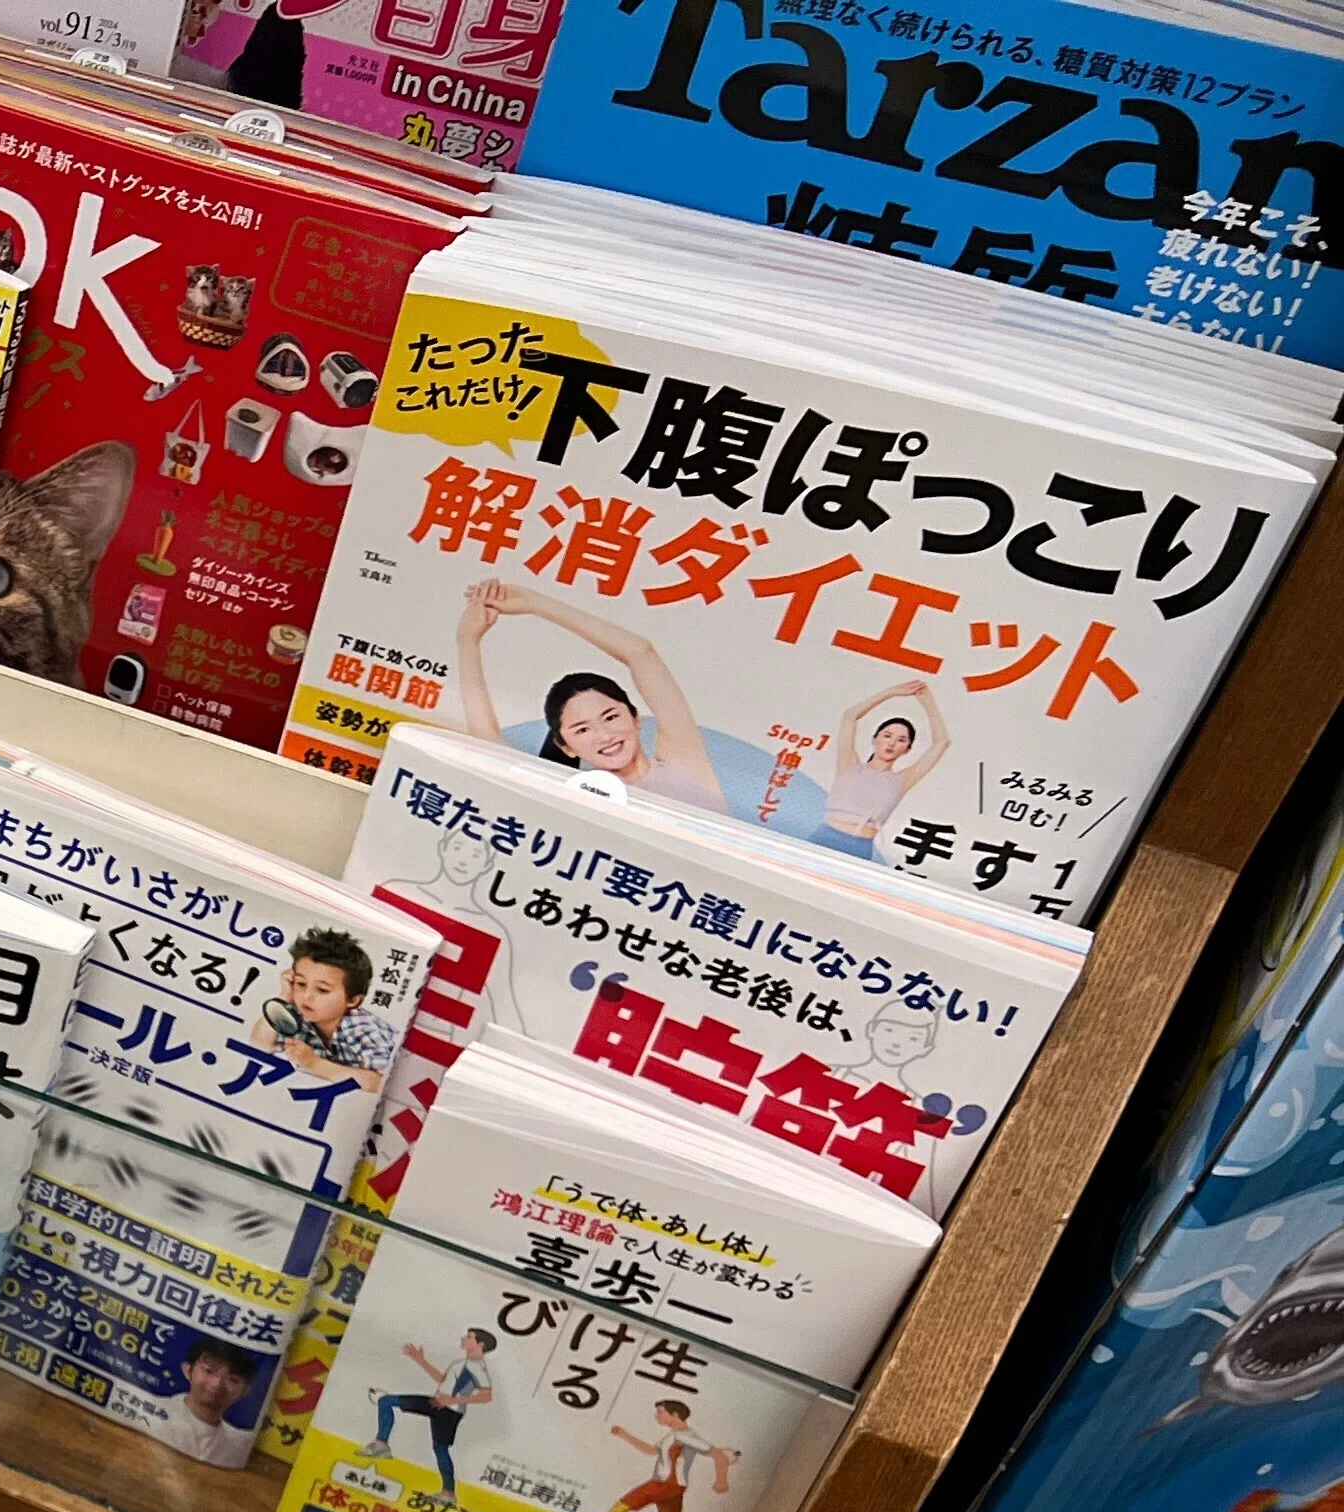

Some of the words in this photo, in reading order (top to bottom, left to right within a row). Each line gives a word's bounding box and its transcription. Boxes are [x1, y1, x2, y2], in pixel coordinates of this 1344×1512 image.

[392, 67, 419, 96] in
[426, 71, 527, 121] China
[591, 0, 1344, 268] Tarzan
[1181, 190, 1331, 252] 今年こそ、
[1156, 228, 1323, 291] 疲れない!
[1145, 265, 1304, 328] 老けない!
[408, 321, 547, 374] たった
[395, 373, 539, 423] これだけ!
[538, 353, 1271, 621] 下腹ぽっこり
[407, 455, 1140, 720] 解消ダイエット
[325, 653, 444, 710] 股関節
[337, 633, 449, 678] 下腹に効くのは
[316, 700, 390, 737] 姿勢が
[1000, 771, 1094, 808] みるみる
[1000, 800, 1070, 834] 凹む!
[386, 769, 1022, 1041] 「寝たきり」「要介護」にならない!
[488, 871, 853, 1043] しあわせな老後は、
[89, 1048, 152, 1086] 決定版
[28, 1174, 297, 1309] 科学的に証明された
[540, 1175, 772, 1267] 「うで体・あし体」
[79, 1240, 284, 1347] 視力回復法
